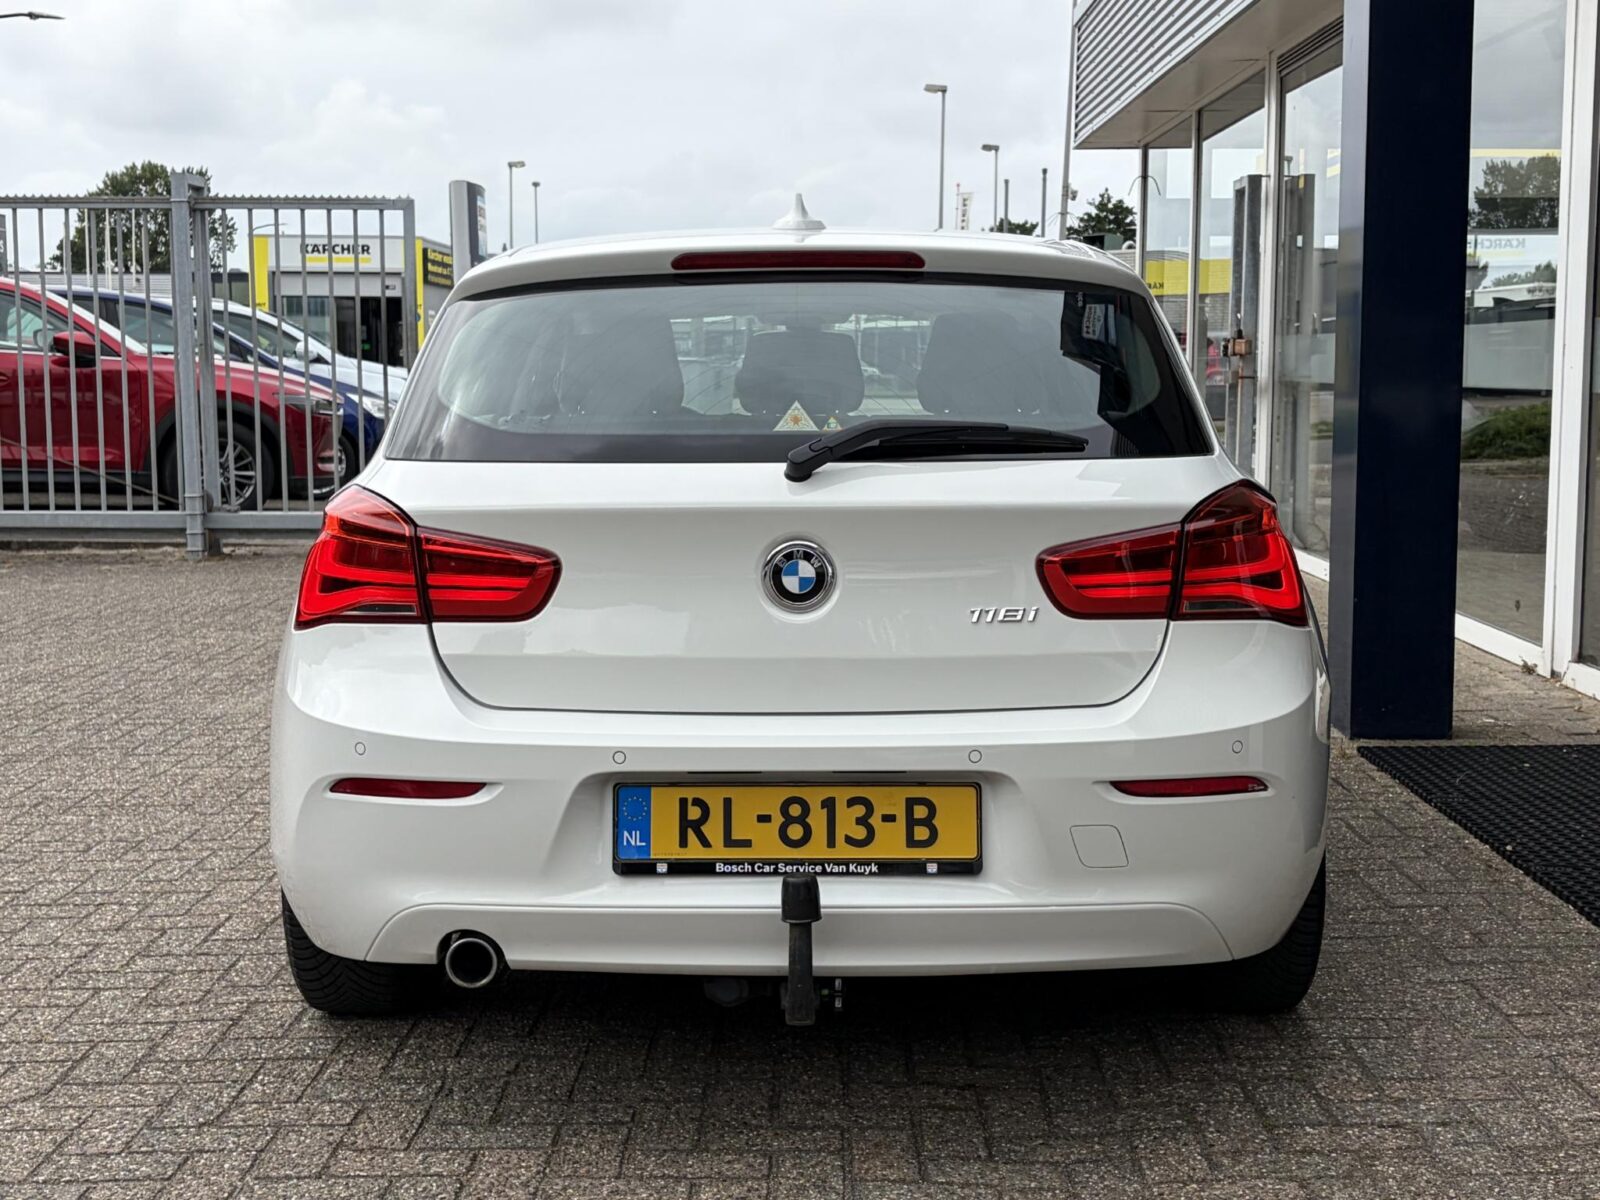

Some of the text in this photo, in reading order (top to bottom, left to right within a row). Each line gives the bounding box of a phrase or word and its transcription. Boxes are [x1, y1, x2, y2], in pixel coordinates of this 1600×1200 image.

[776, 549, 822, 568] BMW
[969, 606, 1039, 623] 118i
[678, 796, 939, 849] RL-813-B
[623, 830, 647, 846] NL
[715, 862, 879, 875] Bosch Car Service Van Kuyk
